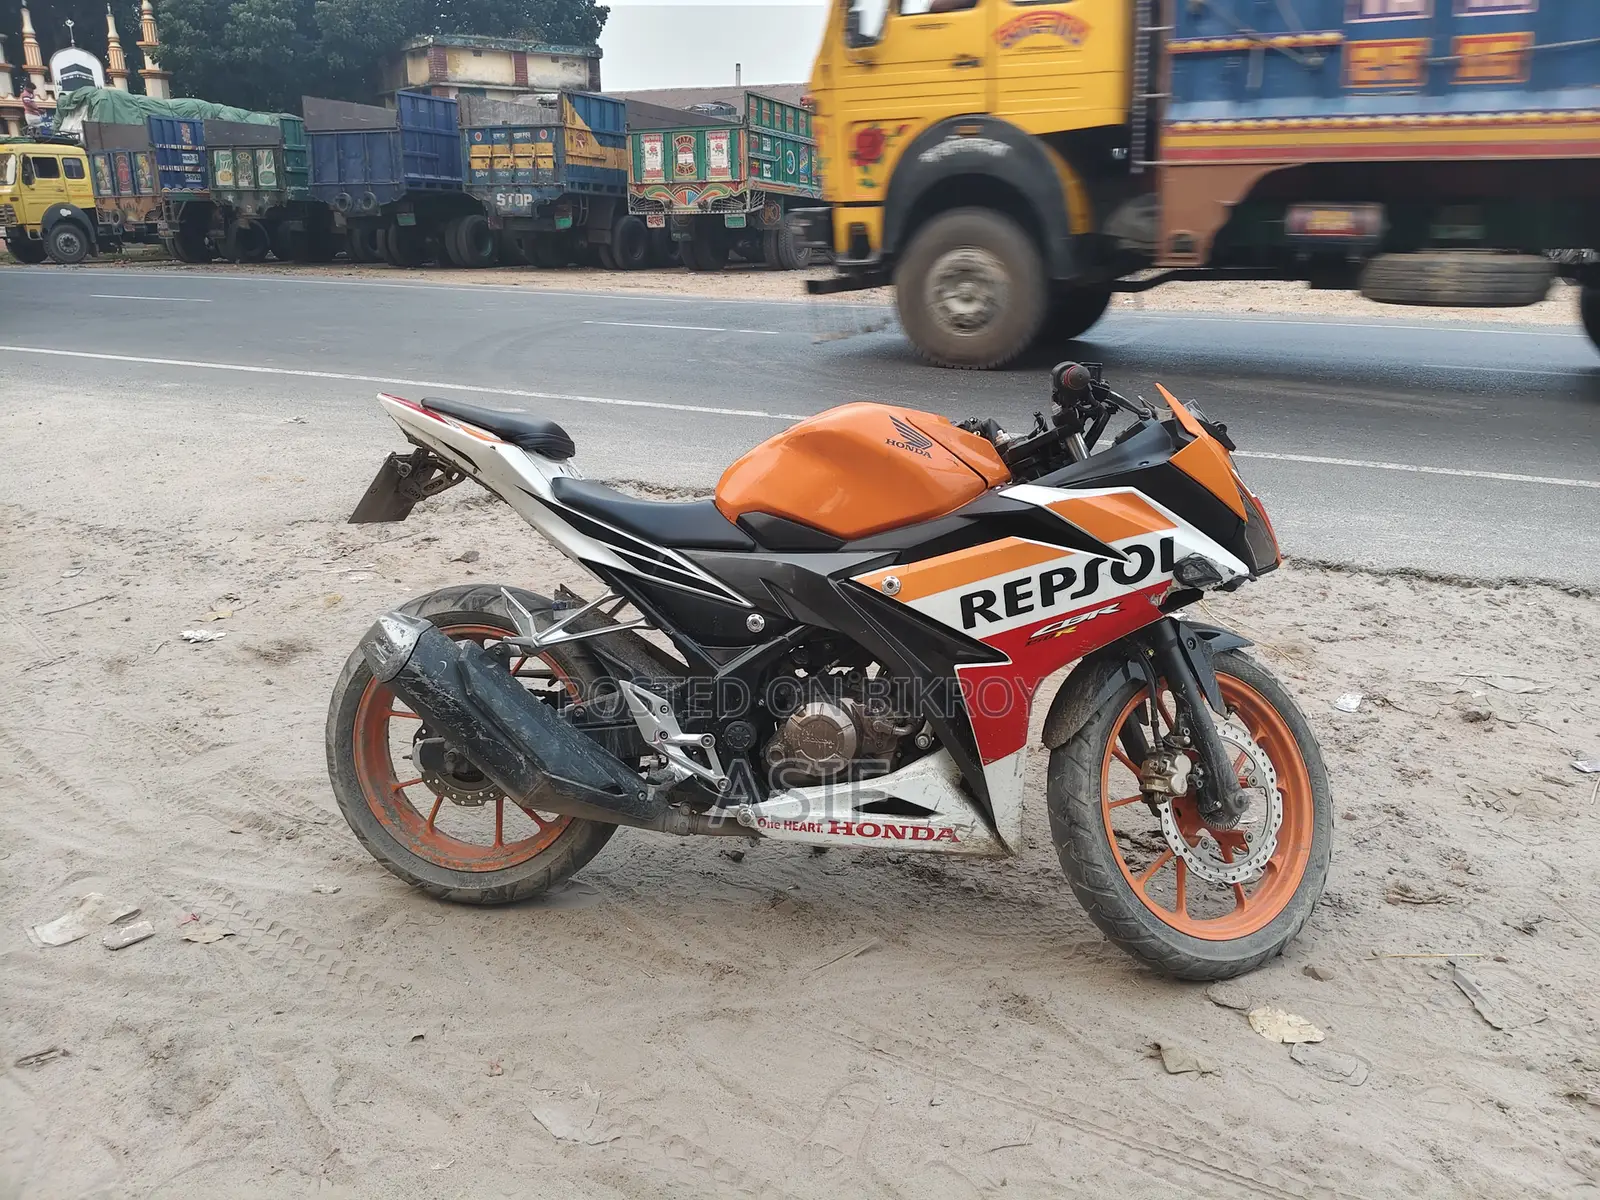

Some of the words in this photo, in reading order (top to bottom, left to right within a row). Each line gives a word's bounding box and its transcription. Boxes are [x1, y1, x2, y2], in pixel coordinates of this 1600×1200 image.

[675, 135, 694, 147] TATA
[496, 193, 533, 207] STOP
[885, 438, 932, 459] HONDA
[959, 536, 1175, 630] REPSOL
[1029, 602, 1123, 639] CBR
[828, 820, 962, 843] HONDA
